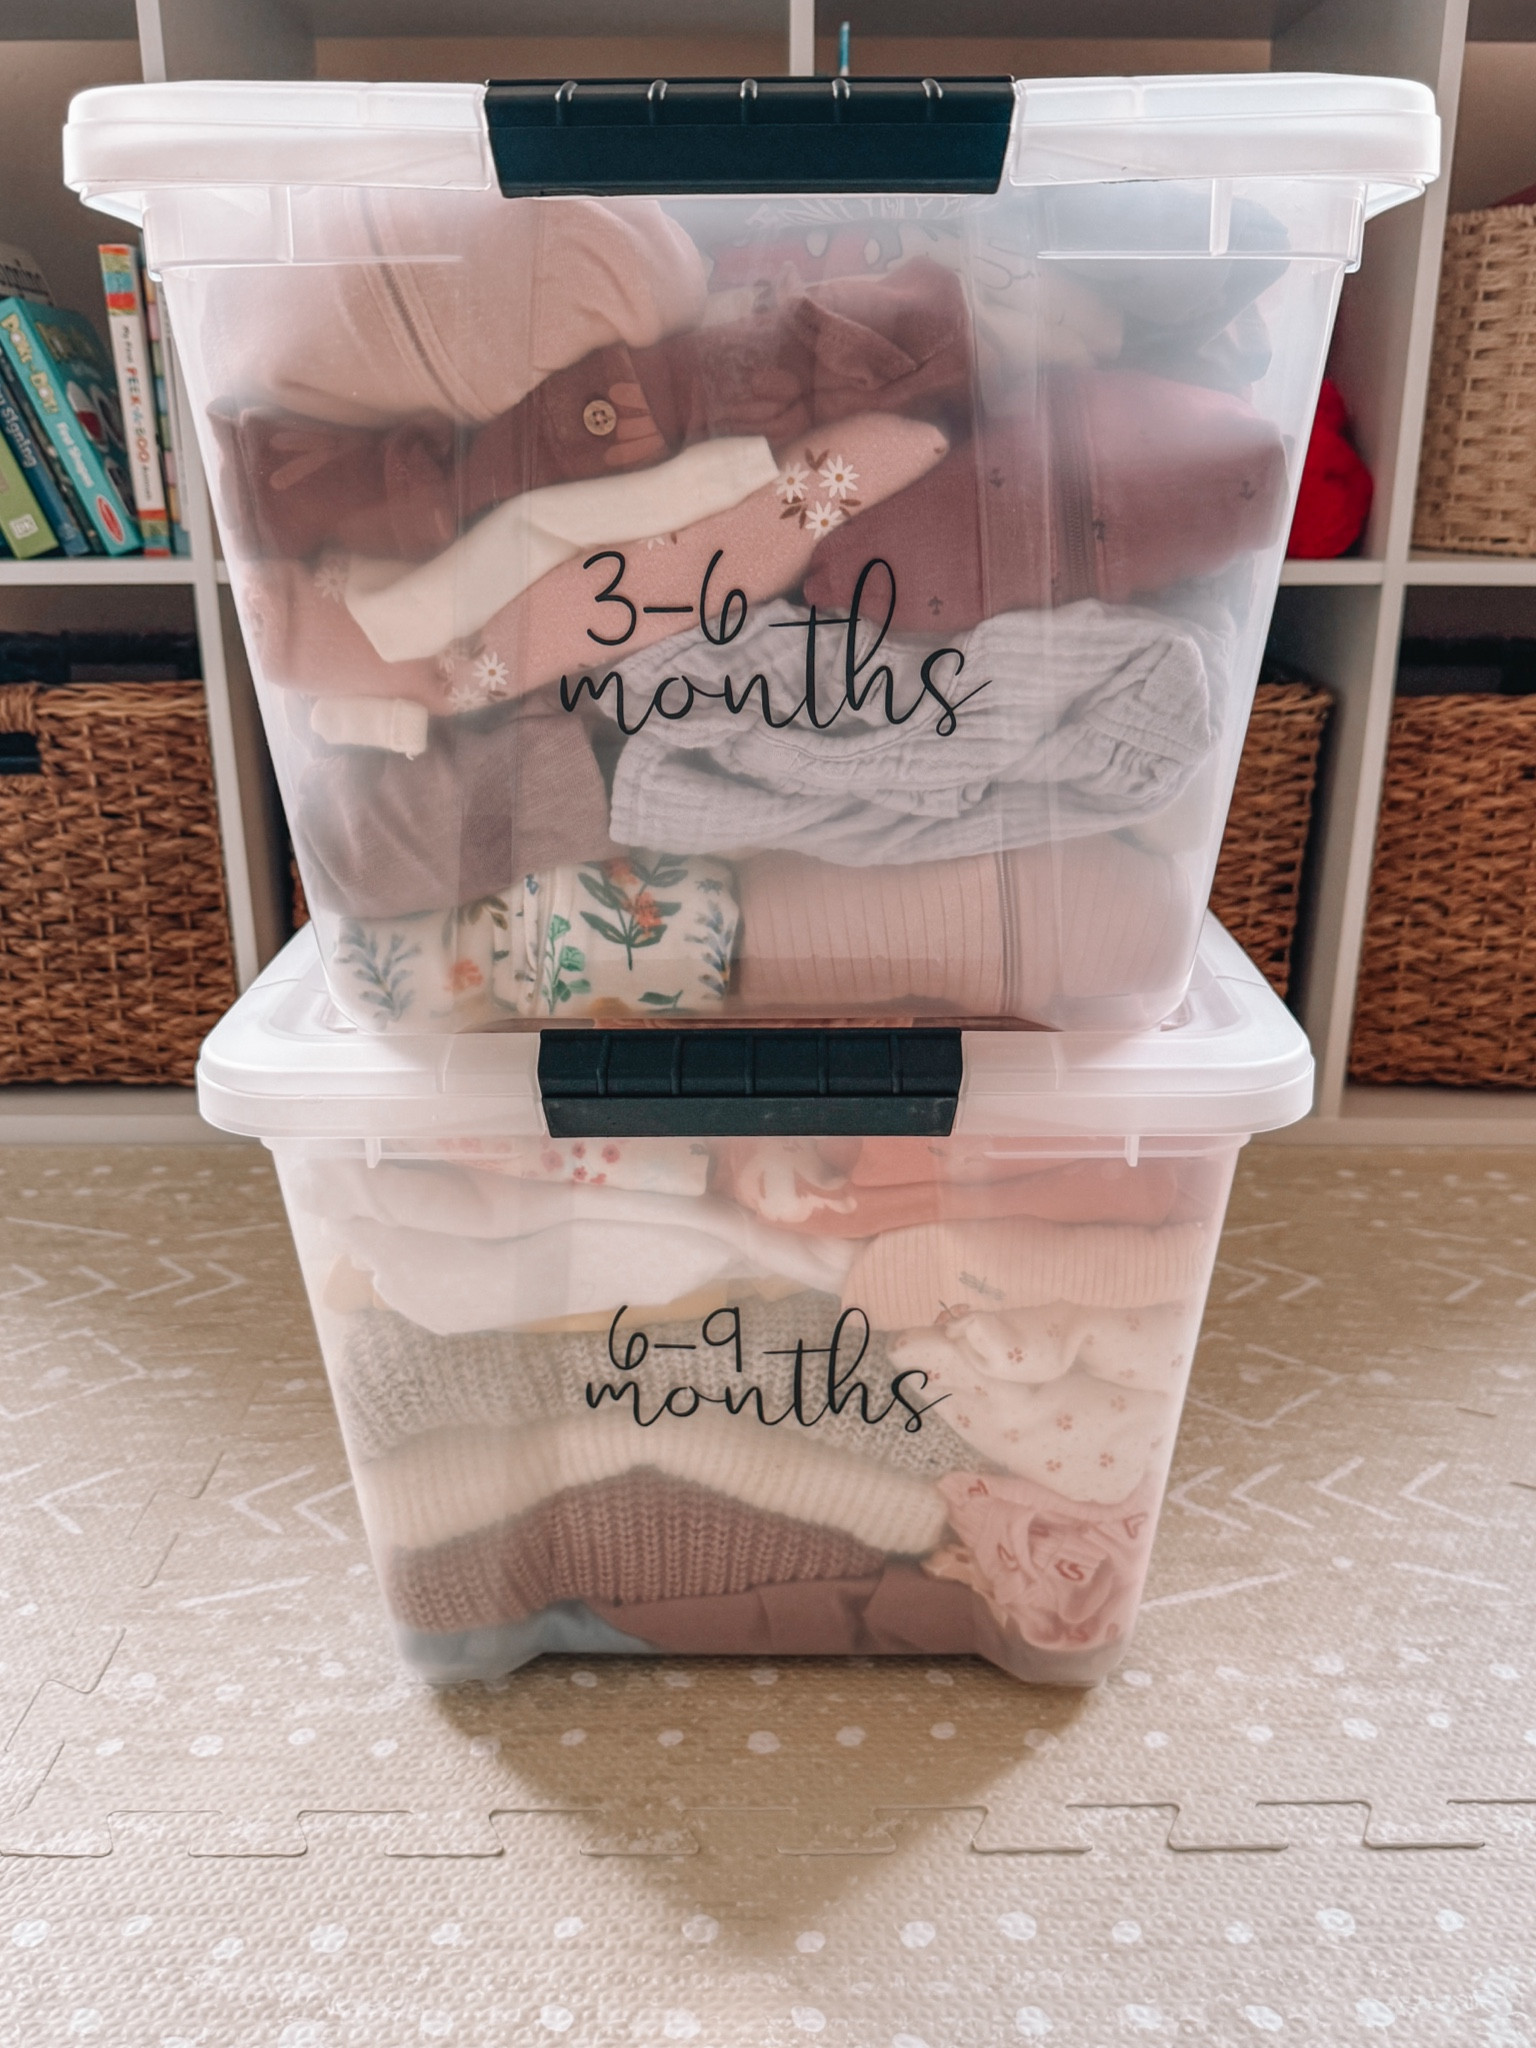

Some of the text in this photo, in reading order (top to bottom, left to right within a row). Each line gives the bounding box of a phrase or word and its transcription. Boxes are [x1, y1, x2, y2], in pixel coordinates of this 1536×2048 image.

[2, 406, 37, 468] Signing
[583, 549, 748, 646] 3-6
[560, 558, 992, 737] months
[585, 1307, 953, 1433] months
[608, 1305, 742, 1373] 6-9
